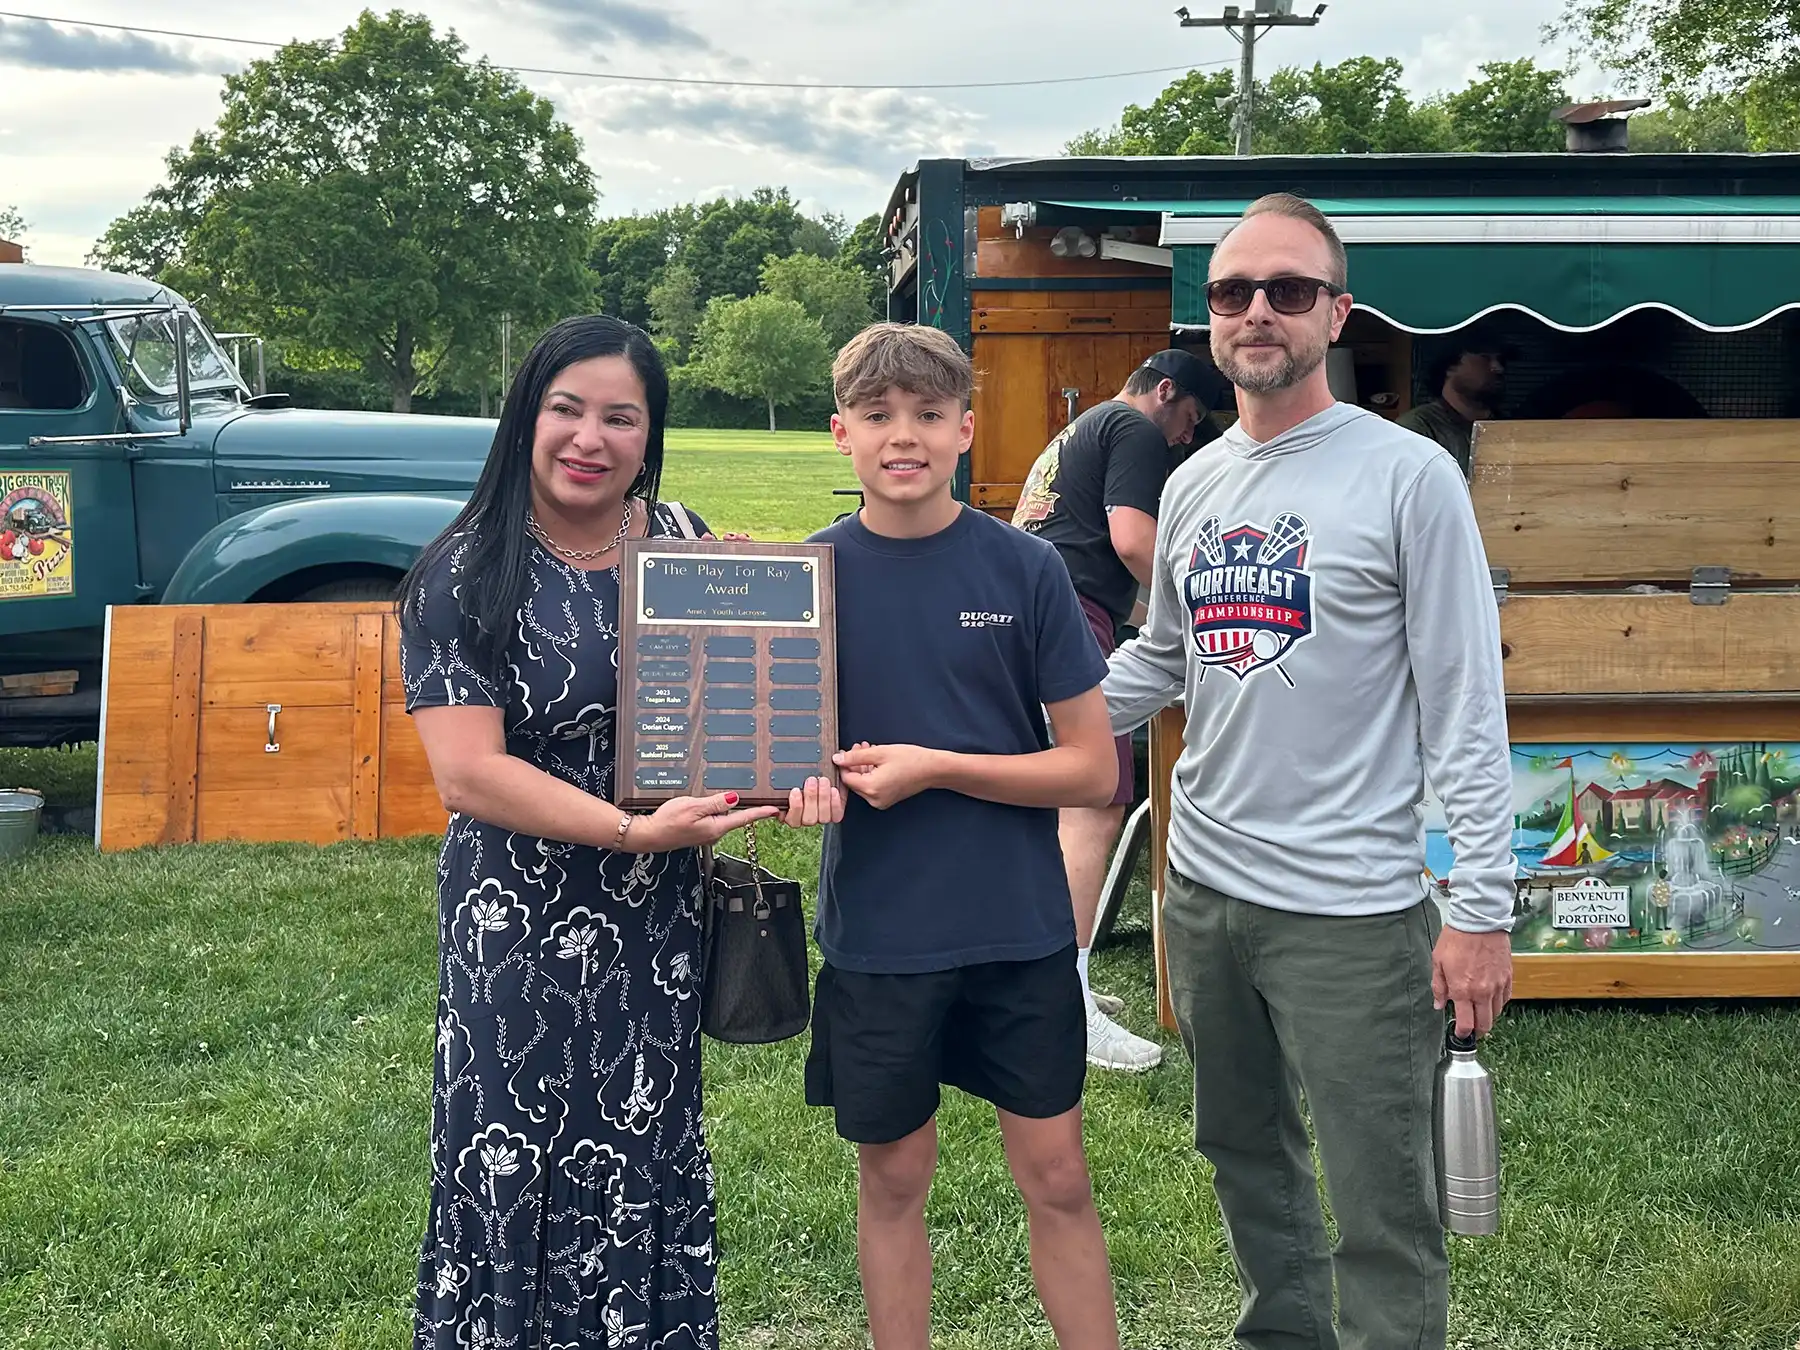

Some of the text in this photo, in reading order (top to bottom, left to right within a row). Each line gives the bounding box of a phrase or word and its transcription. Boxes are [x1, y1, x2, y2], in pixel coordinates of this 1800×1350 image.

[16, 475, 44, 488] GREEN
[32, 543, 70, 581] Pizza
[662, 563, 791, 581] The Play For Ray
[705, 583, 749, 595] Award
[1190, 565, 1296, 601] NORTHEAST
[1205, 594, 1266, 605] CONFERENCE
[712, 608, 734, 616] Youth
[738, 609, 769, 617] Lacrosse
[959, 611, 1014, 624] DUCATI
[1196, 605, 1292, 622] CHAMPIONSHIP
[961, 620, 985, 628] 916
[1557, 892, 1625, 901] BENVENUTI
[1588, 904, 1596, 912] A
[1558, 913, 1626, 924] PORTOFINO
